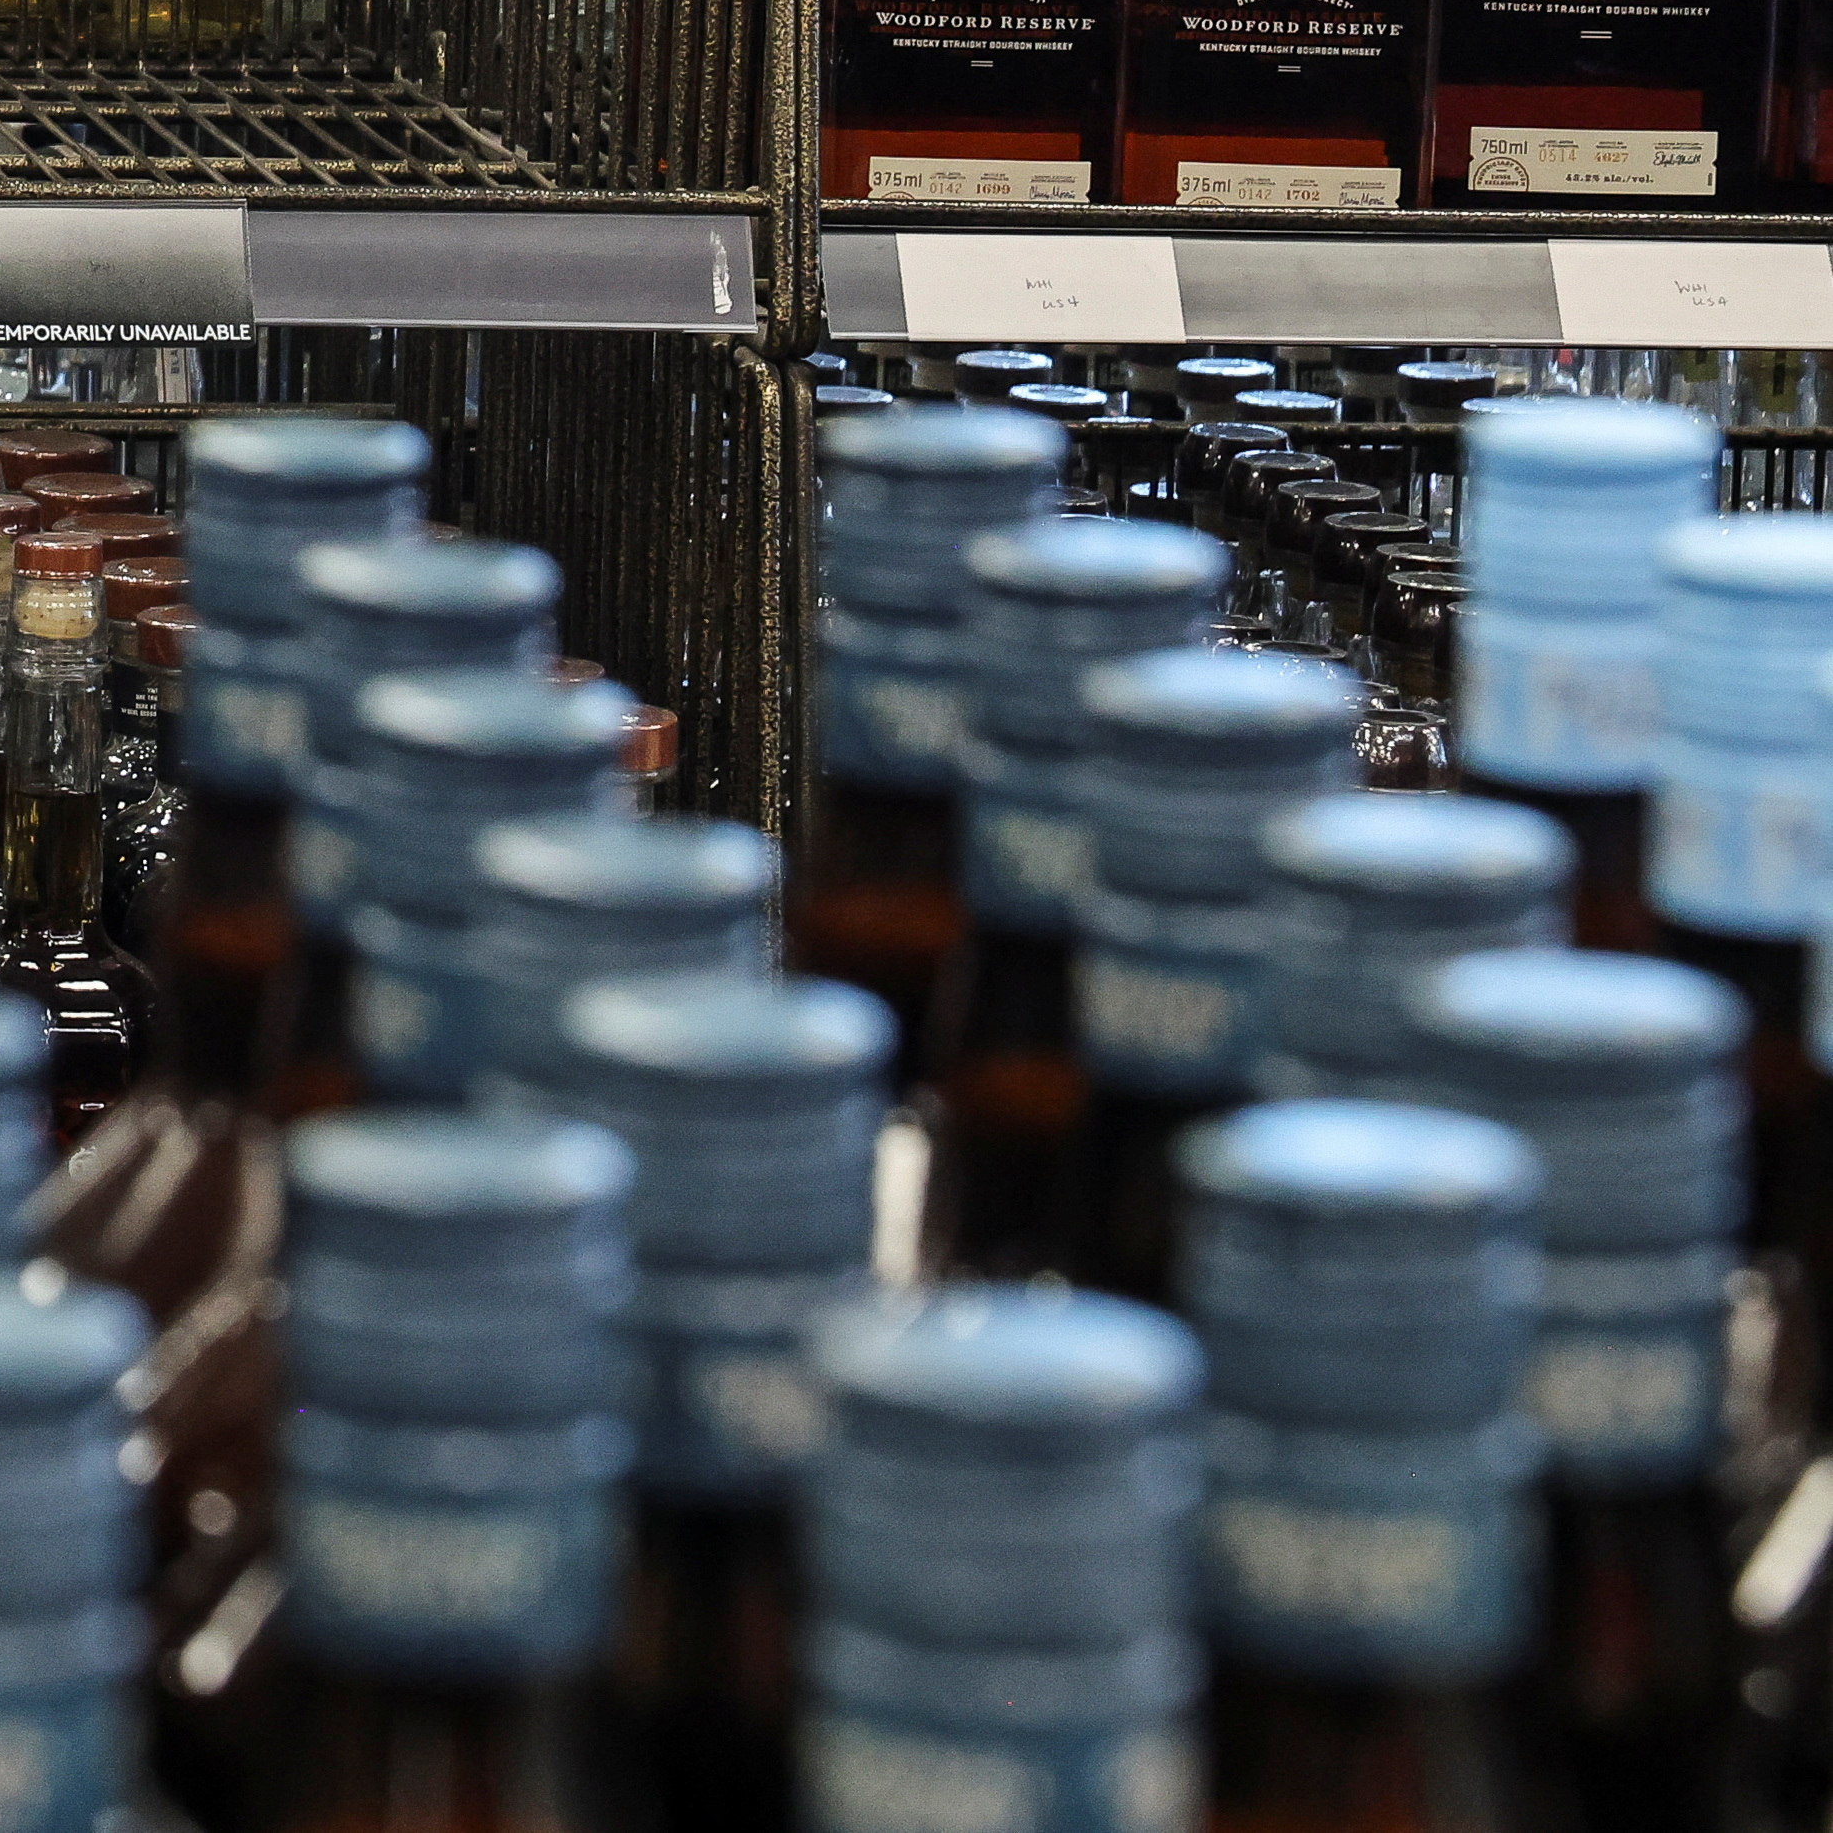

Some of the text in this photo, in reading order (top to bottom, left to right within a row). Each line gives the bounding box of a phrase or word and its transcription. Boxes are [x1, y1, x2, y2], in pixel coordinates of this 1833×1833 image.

[1484, 1, 1711, 16] KENTUCKY STRAIGHT BOURBON WHISKEY
[876, 12, 1092, 30] WOODFORD RESERVE
[1183, 16, 1401, 36] WOODFORD RESERVE
[893, 38, 1073, 51] KENTUCKY STRAIGHT BOURBON WHISKEY
[1199, 42, 1382, 56] KENTUCKY STRAIGHT BOURBON WHISKEY
[1026, 278, 1052, 290] WHI
[1674, 280, 1707, 294] WHI
[120, 324, 252, 341] UNAVAILABLE
